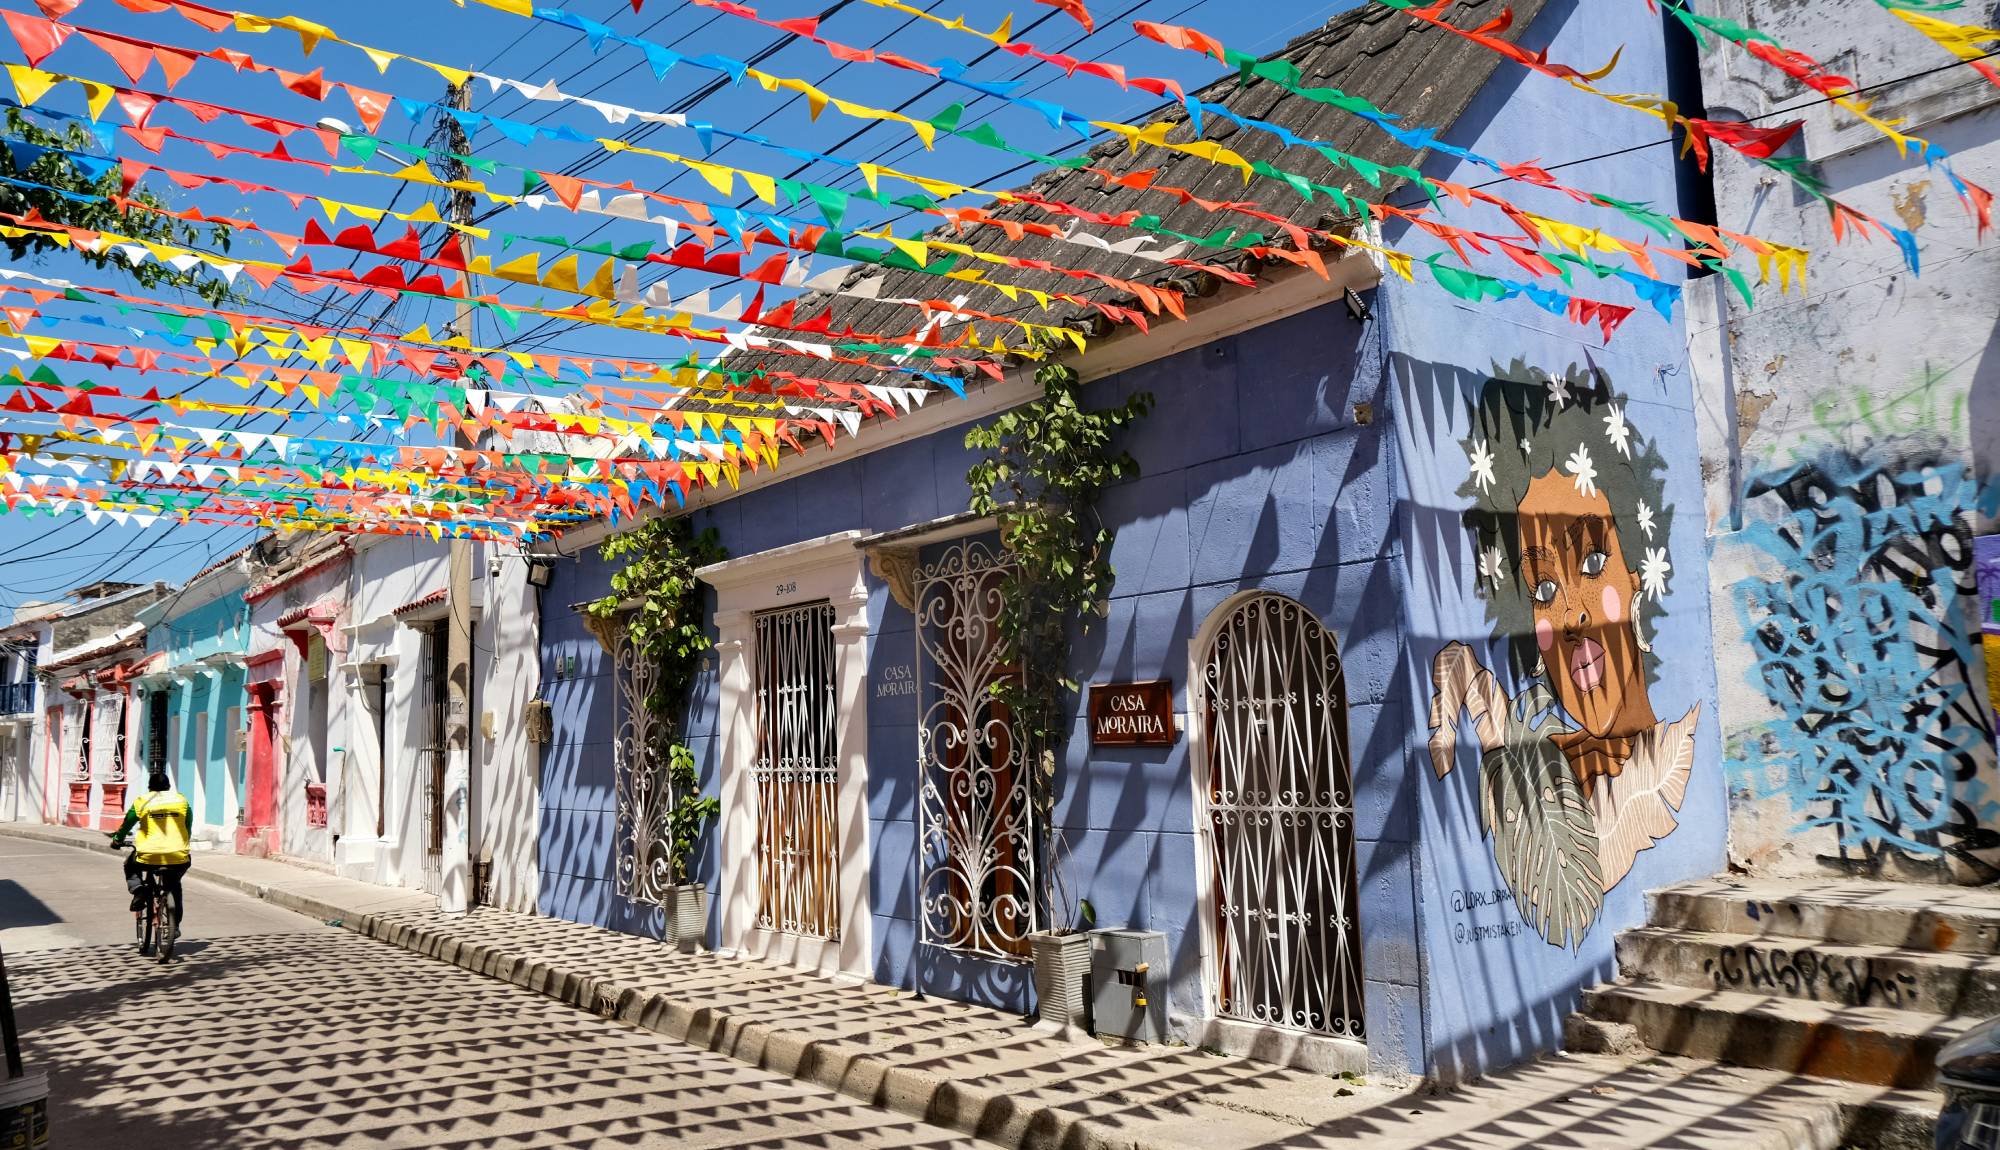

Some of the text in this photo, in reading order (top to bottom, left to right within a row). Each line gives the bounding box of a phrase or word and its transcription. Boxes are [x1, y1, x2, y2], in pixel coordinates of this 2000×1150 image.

[885, 665, 912, 680] CASA
[1110, 694, 1146, 712] CASA
[1097, 714, 1164, 735] MORAIRA
